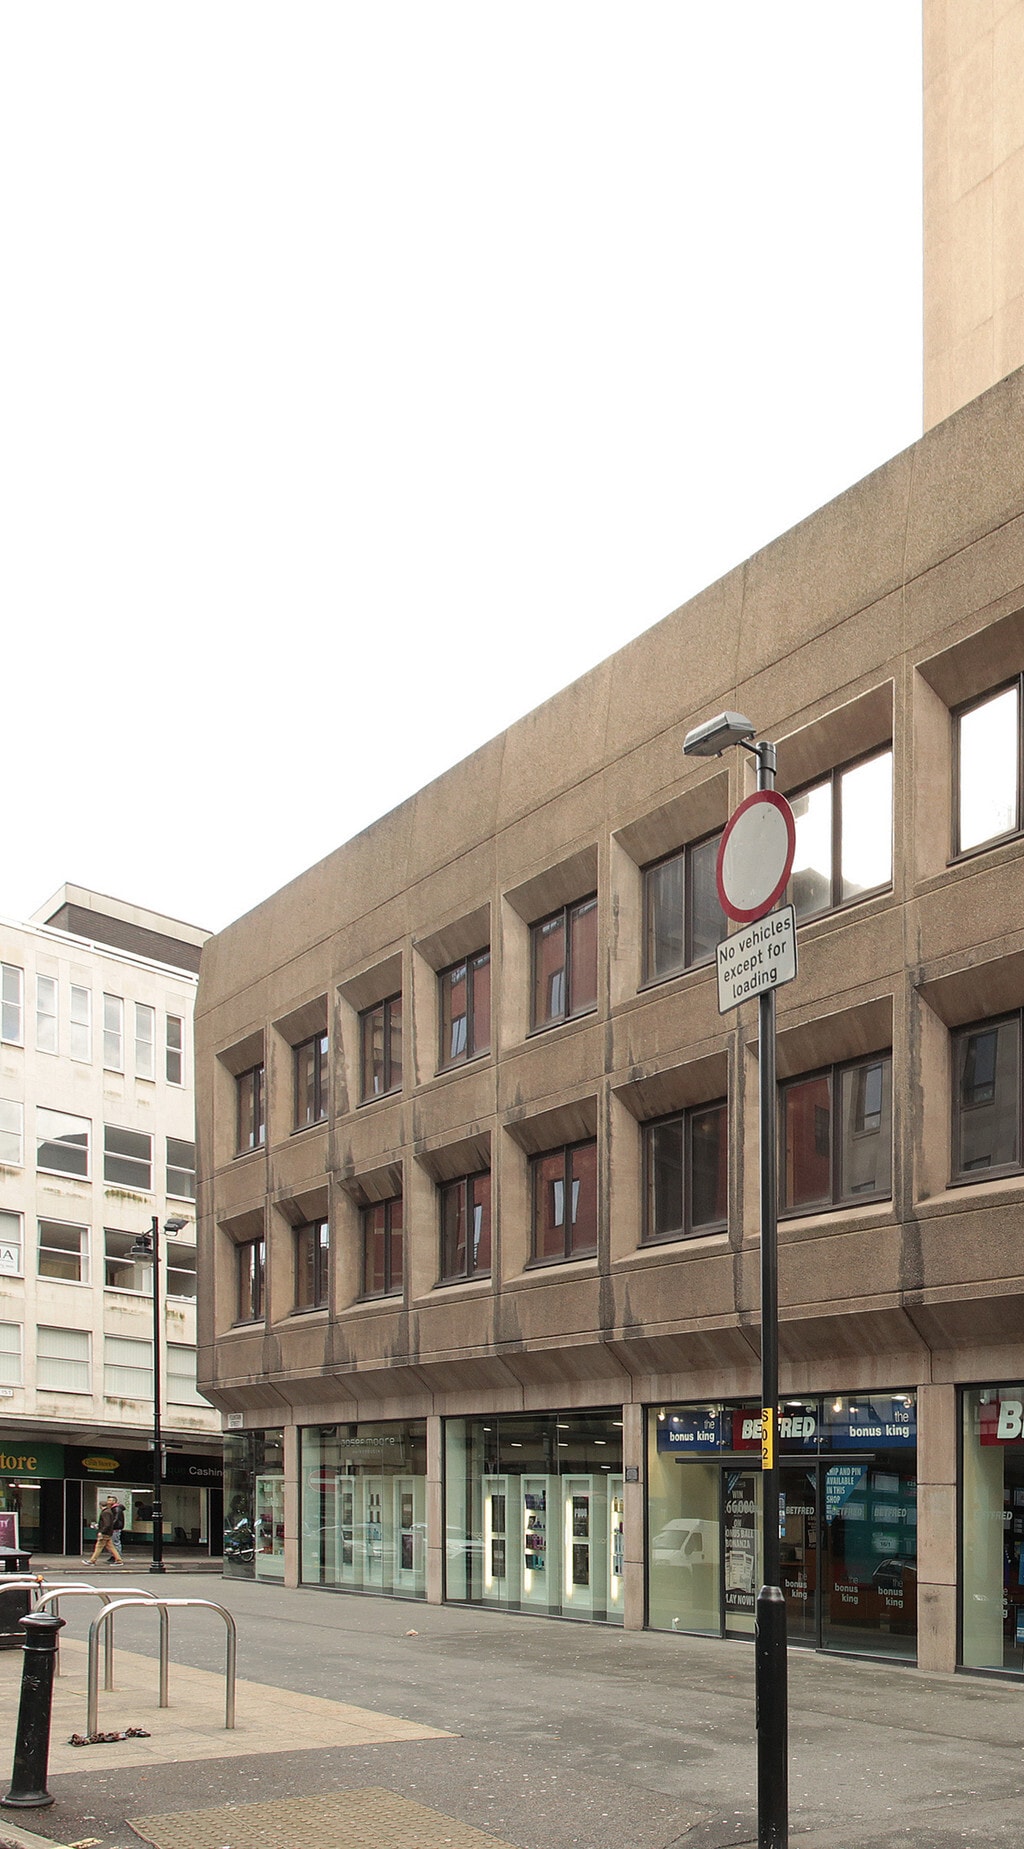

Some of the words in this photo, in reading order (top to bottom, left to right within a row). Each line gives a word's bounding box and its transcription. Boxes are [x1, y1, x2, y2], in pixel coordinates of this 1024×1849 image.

[719, 946, 735, 965] No
[739, 918, 791, 952] vehicles
[724, 951, 763, 982] except
[768, 941, 787, 959] for
[732, 967, 777, 998] loading
[894, 1410, 909, 1422] the
[703, 1419, 715, 1430] the
[742, 1416, 816, 1439] BERED
[669, 1431, 695, 1442] bonus
[697, 1430, 715, 1443] king
[849, 1425, 882, 1438] bonus
[886, 1424, 909, 1438] king
[189, 1466, 223, 1477] Cashin
[840, 1467, 851, 1476] AND
[851, 1467, 862, 1476] PIN
[826, 1476, 854, 1485] AVAILABLE
[732, 1490, 744, 1499] WIN
[826, 1486, 833, 1494] IN
[833, 1486, 846, 1495] THIS
[826, 1495, 841, 1504] SHOP
[785, 1506, 815, 1515] BETFRED
[874, 1507, 907, 1517] BETFRED
[784, 1578, 808, 1588] bonus
[834, 1583, 859, 1593] bonus
[791, 1589, 808, 1600] king
[877, 1586, 903, 1596] bonus
[725, 1594, 738, 1605] LAY
[841, 1594, 859, 1605] king
[885, 1597, 904, 1609] king
